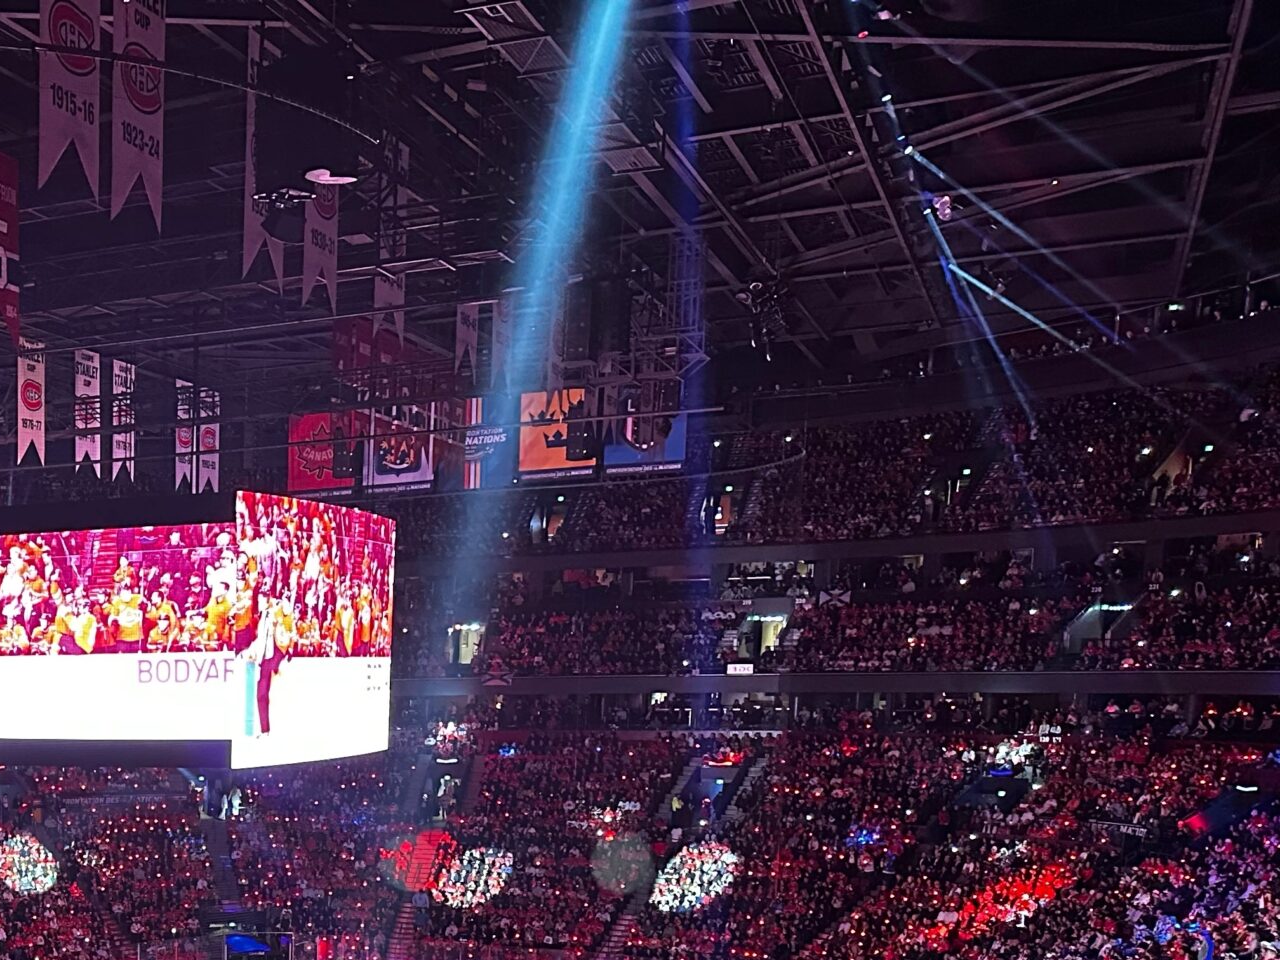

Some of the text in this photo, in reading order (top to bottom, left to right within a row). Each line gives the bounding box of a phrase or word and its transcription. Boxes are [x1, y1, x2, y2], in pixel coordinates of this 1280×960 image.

[134, 9, 151, 31] CUP
[50, 82, 95, 126] 1915-16
[121, 119, 160, 160] 1923-24
[465, 433, 508, 446] NATIONS
[303, 446, 334, 461] CANAD
